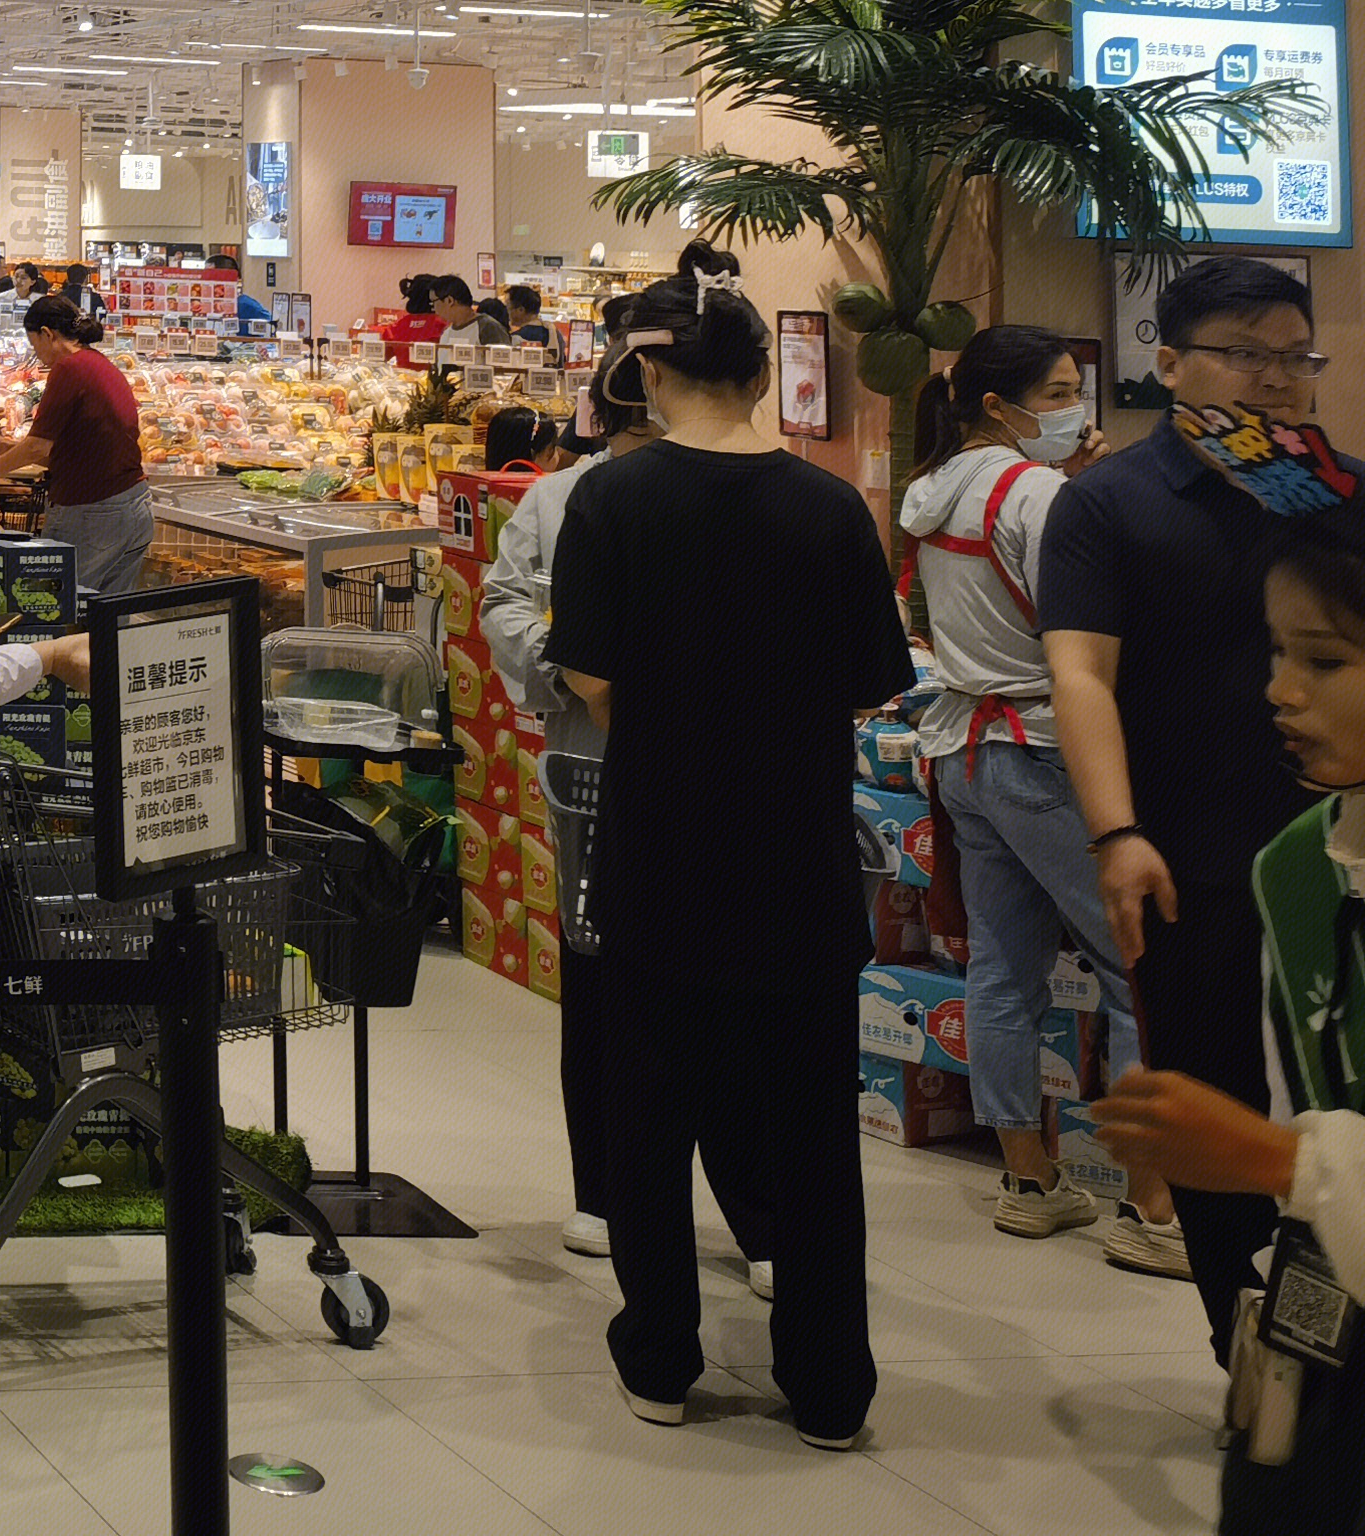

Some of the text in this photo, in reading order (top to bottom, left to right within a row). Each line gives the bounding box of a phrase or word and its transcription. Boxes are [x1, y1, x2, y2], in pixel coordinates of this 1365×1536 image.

[1145, 41, 1206, 59] 会员专享品
[1263, 49, 1324, 65] 专享运费券
[177, 627, 208, 641] 7FRESH
[126, 655, 208, 695] 温馨提示
[132, 727, 207, 755] 欢迎光临京东
[134, 793, 203, 821] 请放心使用。
[135, 813, 209, 844] 祝您购物愉快
[3, 974, 44, 996] 七鲜
